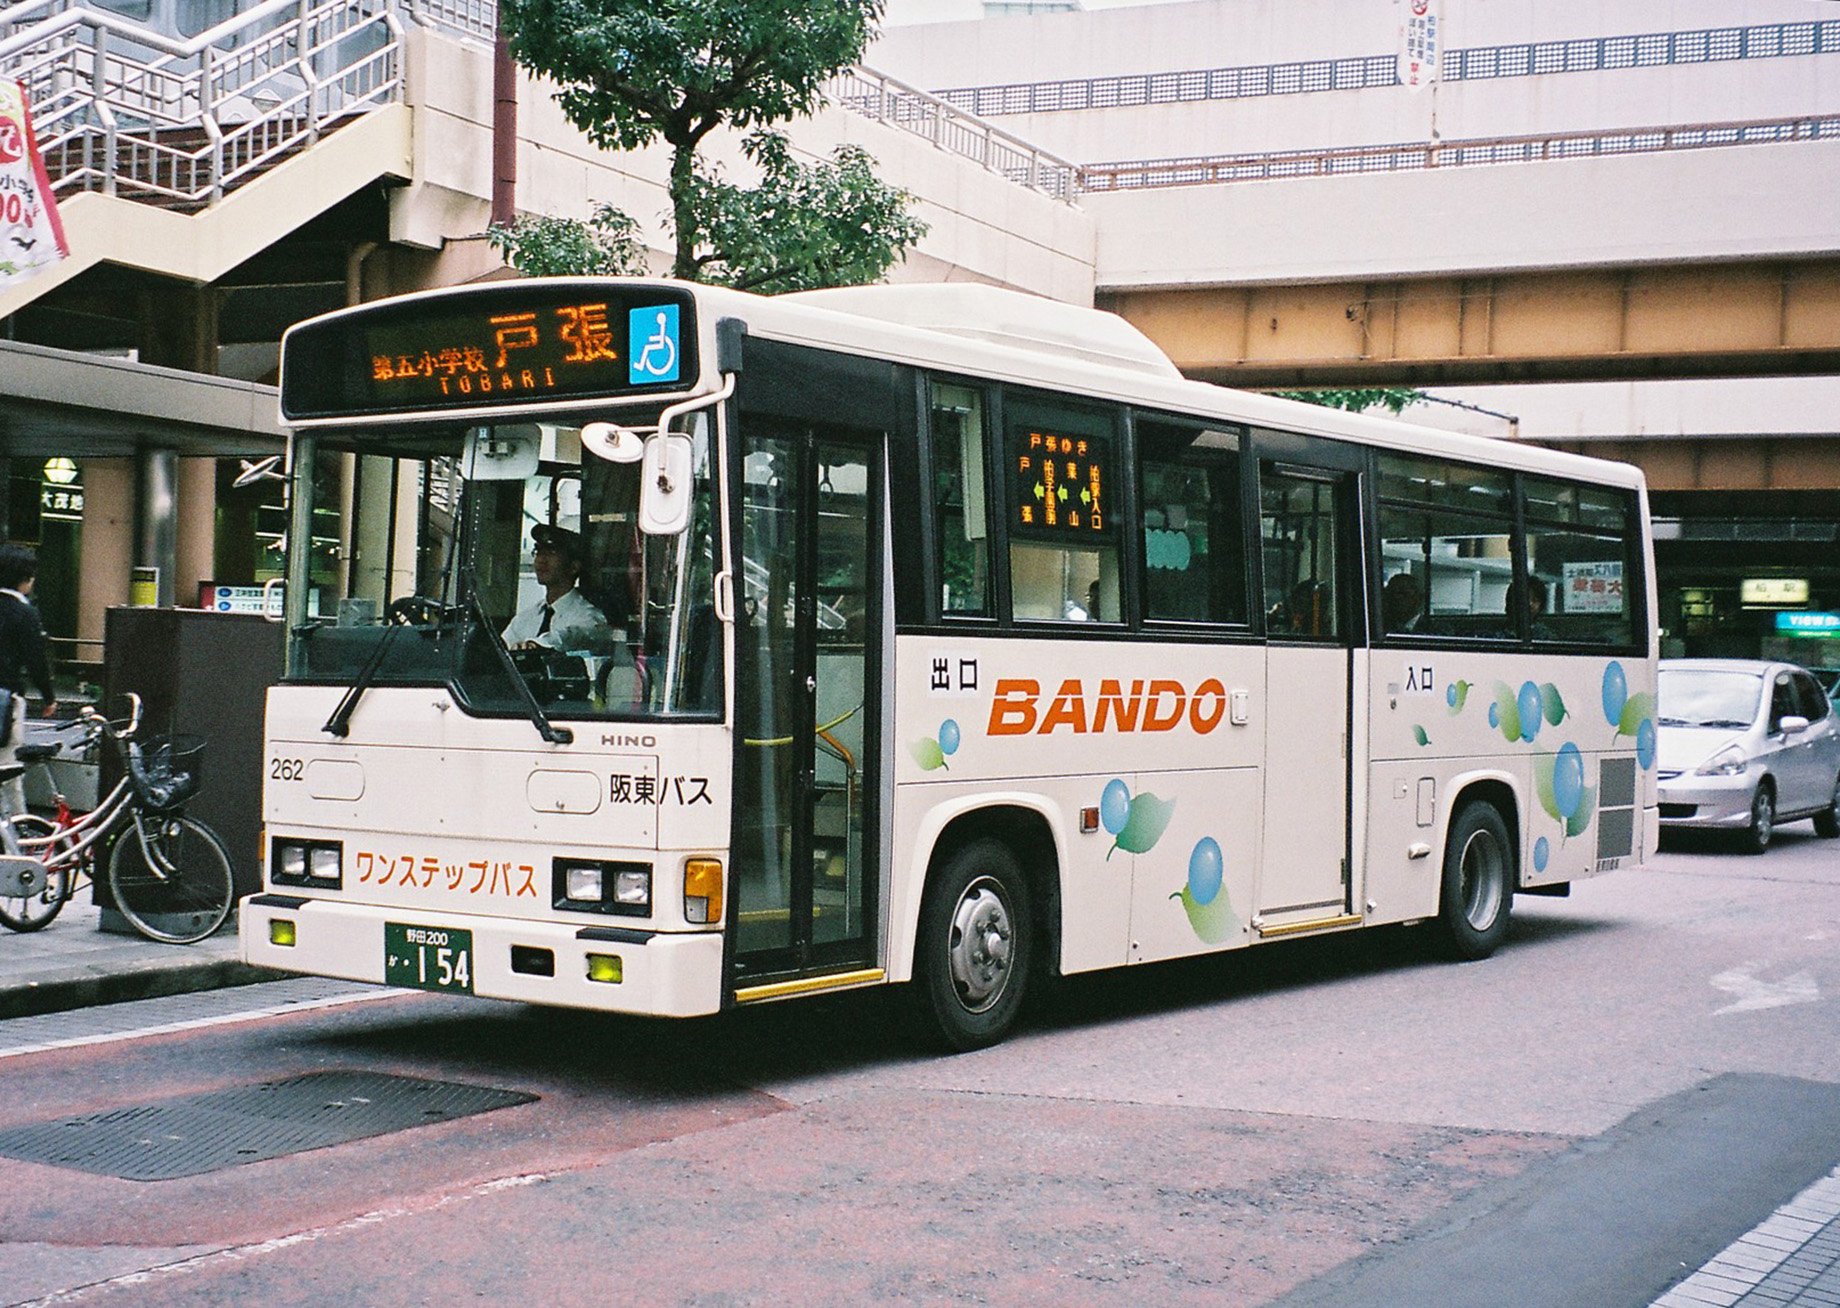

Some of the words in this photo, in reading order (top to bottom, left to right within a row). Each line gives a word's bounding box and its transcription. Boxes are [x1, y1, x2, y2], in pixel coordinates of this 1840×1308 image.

[372, 346, 489, 381] 第五小学校
[489, 303, 618, 369] 戸張
[440, 367, 555, 395] TOBARI
[931, 657, 978, 691] 出口
[1406, 666, 1433, 691] 入口
[986, 678, 1227, 736] BANDO
[601, 734, 657, 748] HINO
[270, 757, 304, 782] 262
[610, 773, 713, 806] 阪東バス
[355, 851, 538, 898] ワンステップバス
